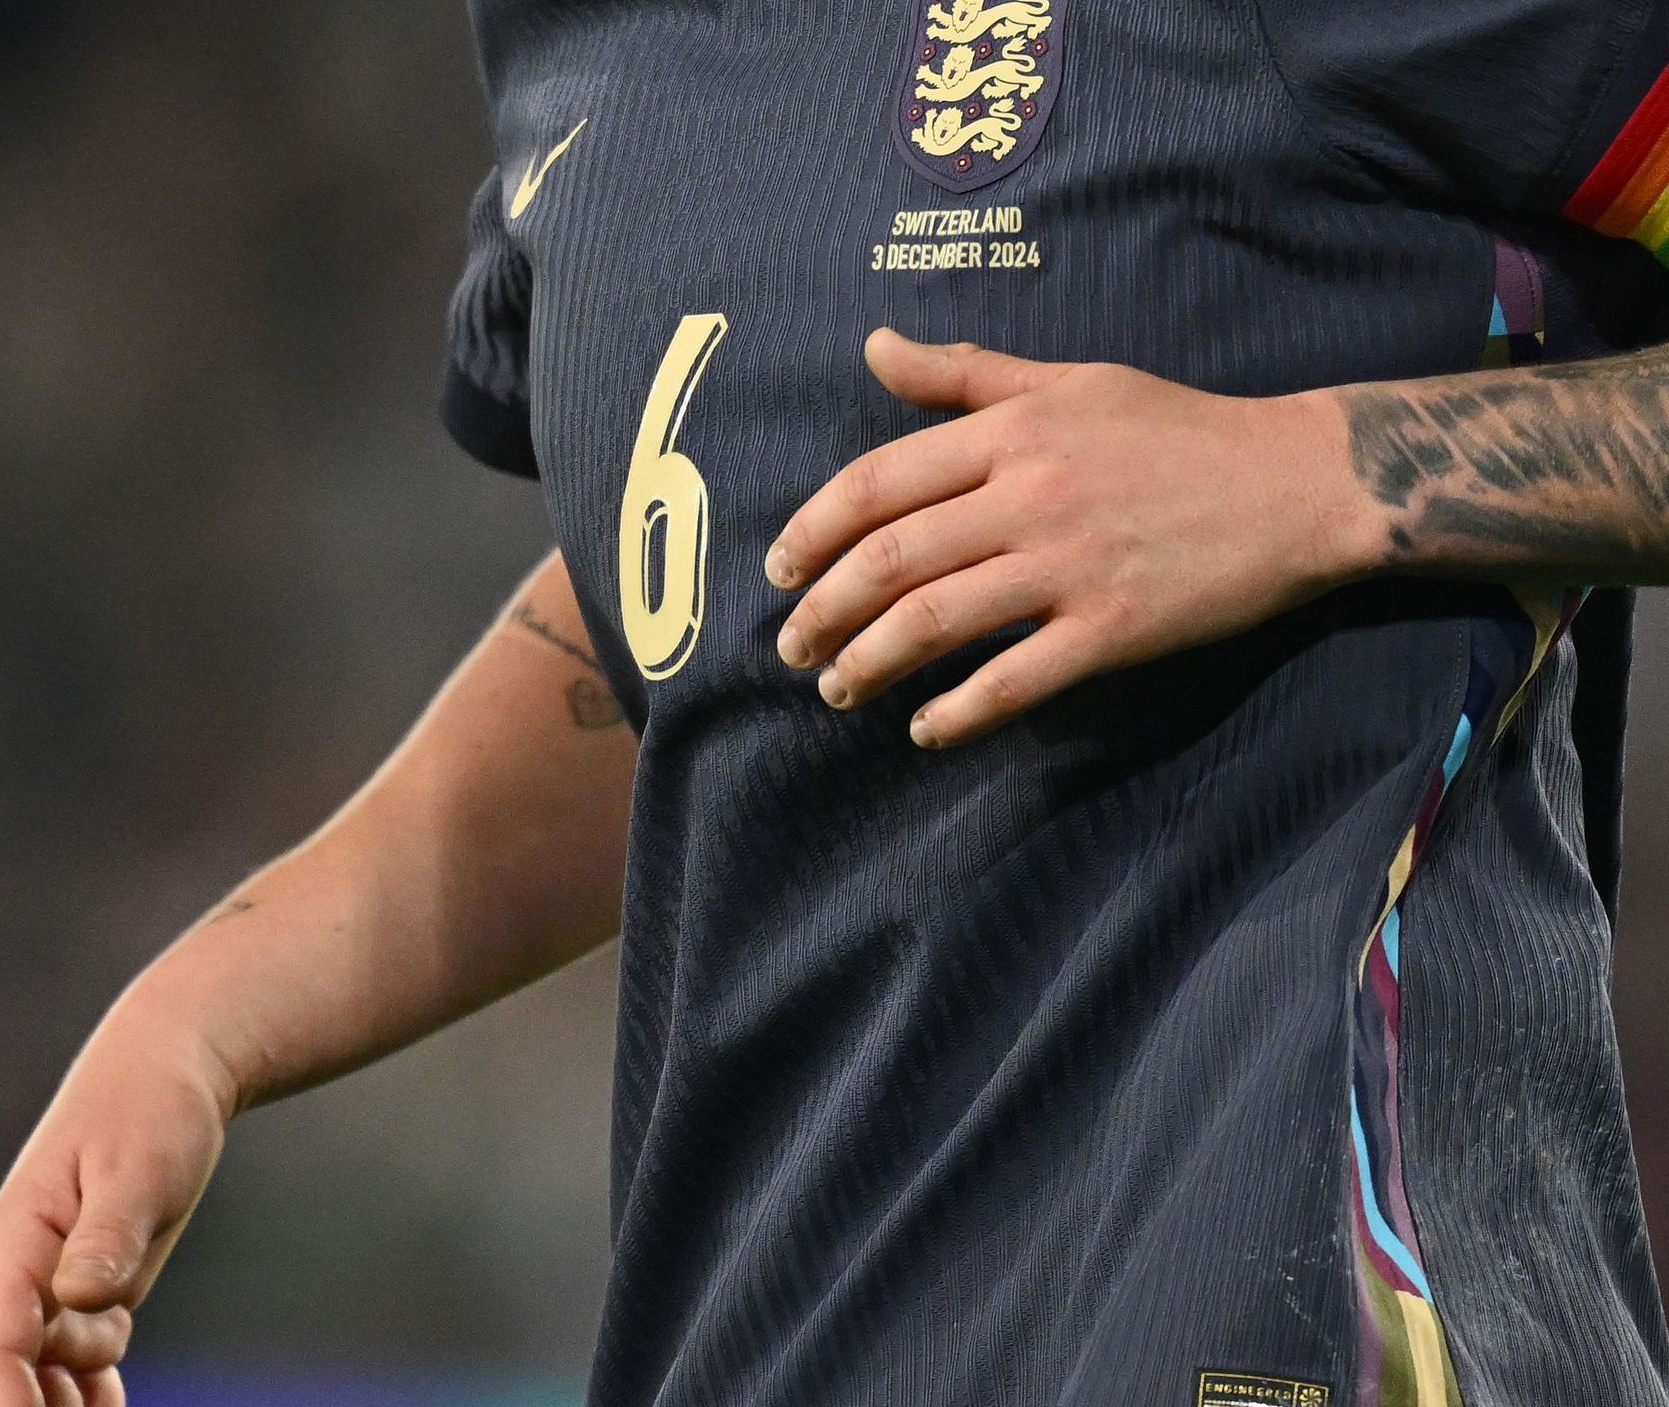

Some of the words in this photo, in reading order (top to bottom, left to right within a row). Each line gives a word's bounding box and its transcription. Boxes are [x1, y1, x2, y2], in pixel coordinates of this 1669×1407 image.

[892, 206, 1022, 236] SWITZERLAND
[871, 244, 883, 271] 3
[886, 242, 982, 270] DECEMBER
[988, 241, 1040, 268] 2024
[619, 313, 728, 681] 6
[1205, 1382, 1292, 1400] ENGINEERED
